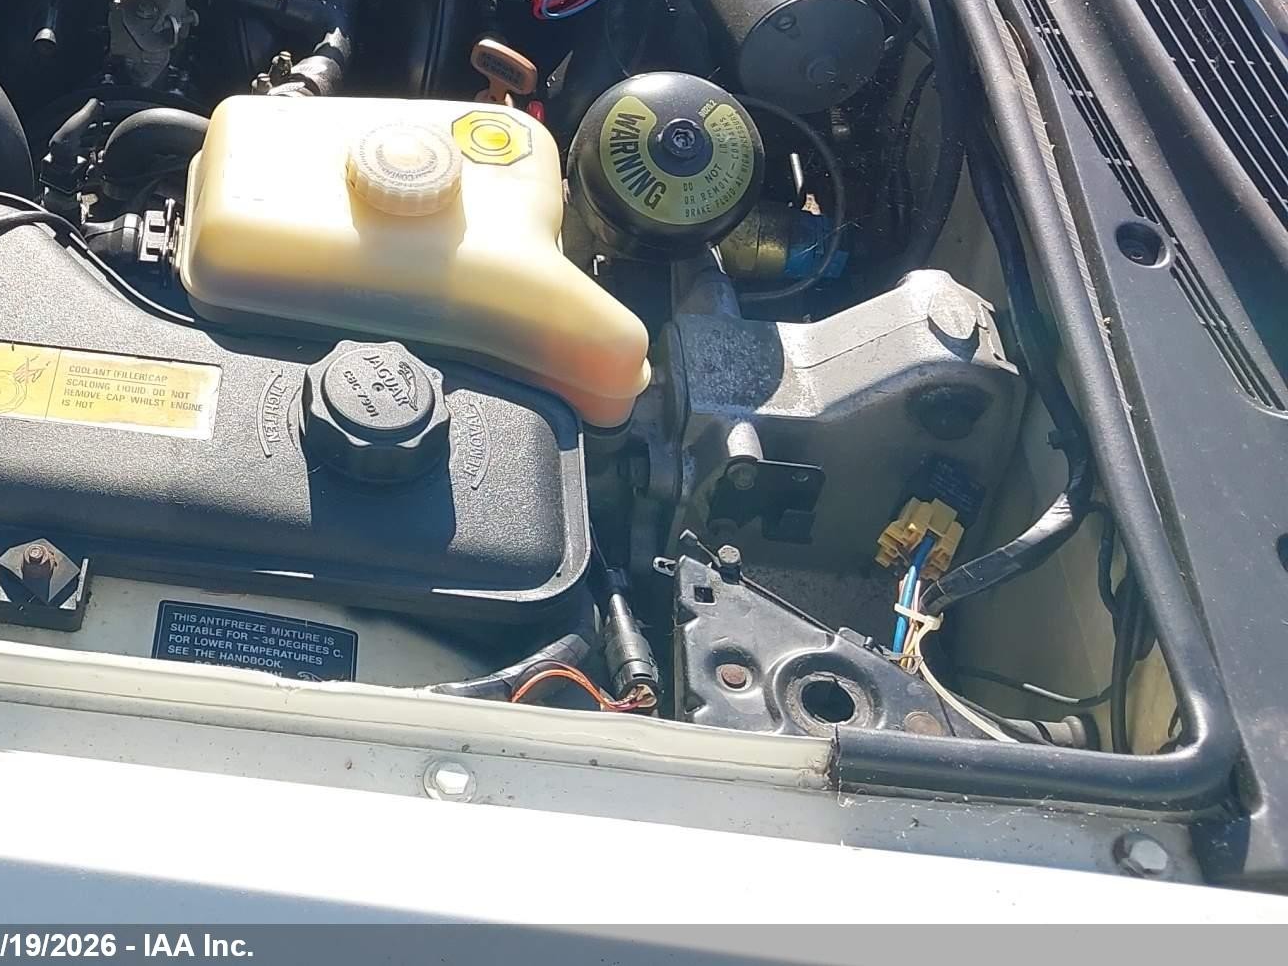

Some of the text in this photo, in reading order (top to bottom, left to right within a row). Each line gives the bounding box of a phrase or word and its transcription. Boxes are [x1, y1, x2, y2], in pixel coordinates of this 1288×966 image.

[609, 112, 667, 210] WARNING
[704, 163, 722, 184] NOT
[685, 204, 712, 218] BRAKE
[69, 365, 111, 377] COOLANT
[363, 354, 411, 407] JAGUAR
[64, 388, 203, 412] REMOVE CAP WHILST ENGINE
[75, 400, 95, 409] HOT
[171, 390, 191, 399] NOT
[263, 384, 288, 444] TIGHTEN
[463, 412, 483, 477] REMOVAL
[170, 624, 223, 638] SUITABLE
[226, 630, 248, 641] FOR
[278, 638, 330, 656] DEGREES
[332, 649, 344, 659] C.
[172, 612, 335, 646] THIS ANTIFREEZE MIXTURE IS
[168, 634, 323, 666] FOR LOWER TEMPERATURES
[168, 644, 189, 655] SEE
[194, 648, 216, 659] THE
[219, 652, 284, 670] HANDBOOK.
